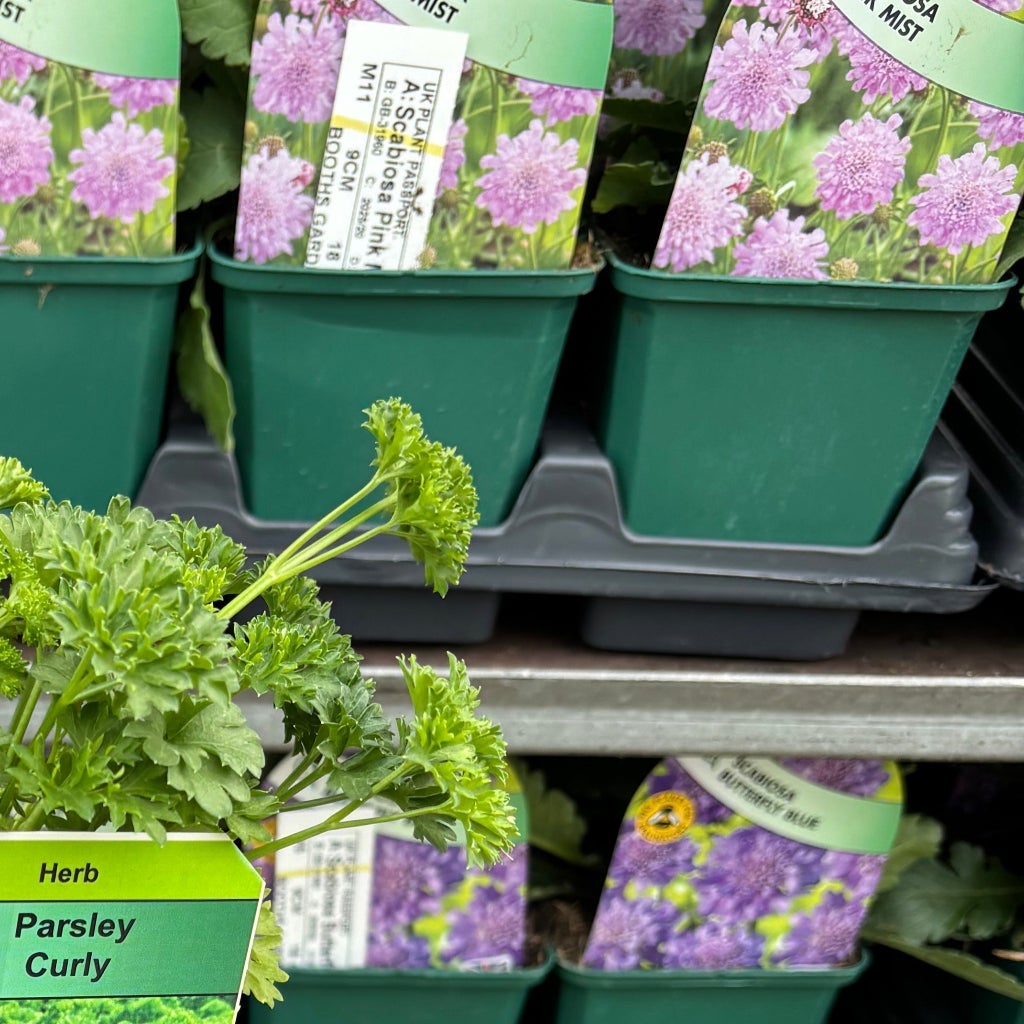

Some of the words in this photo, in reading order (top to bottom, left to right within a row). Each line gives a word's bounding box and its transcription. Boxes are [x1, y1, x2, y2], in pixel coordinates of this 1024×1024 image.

[878, 4, 925, 42] MIST
[354, 62, 378, 103] M11
[400, 79, 421, 101] A:
[420, 82, 437, 104] UK
[410, 107, 432, 156] PLANT
[315, 126, 343, 207] BOOTHS
[337, 150, 362, 193] 9CM
[377, 106, 416, 203] Scabiosa
[394, 160, 420, 237] PASSPORT
[325, 242, 343, 263] 18
[366, 211, 394, 256] Pink
[38, 863, 100, 884] Herb
[14, 912, 137, 944] Parsley
[24, 951, 112, 983] Curly
